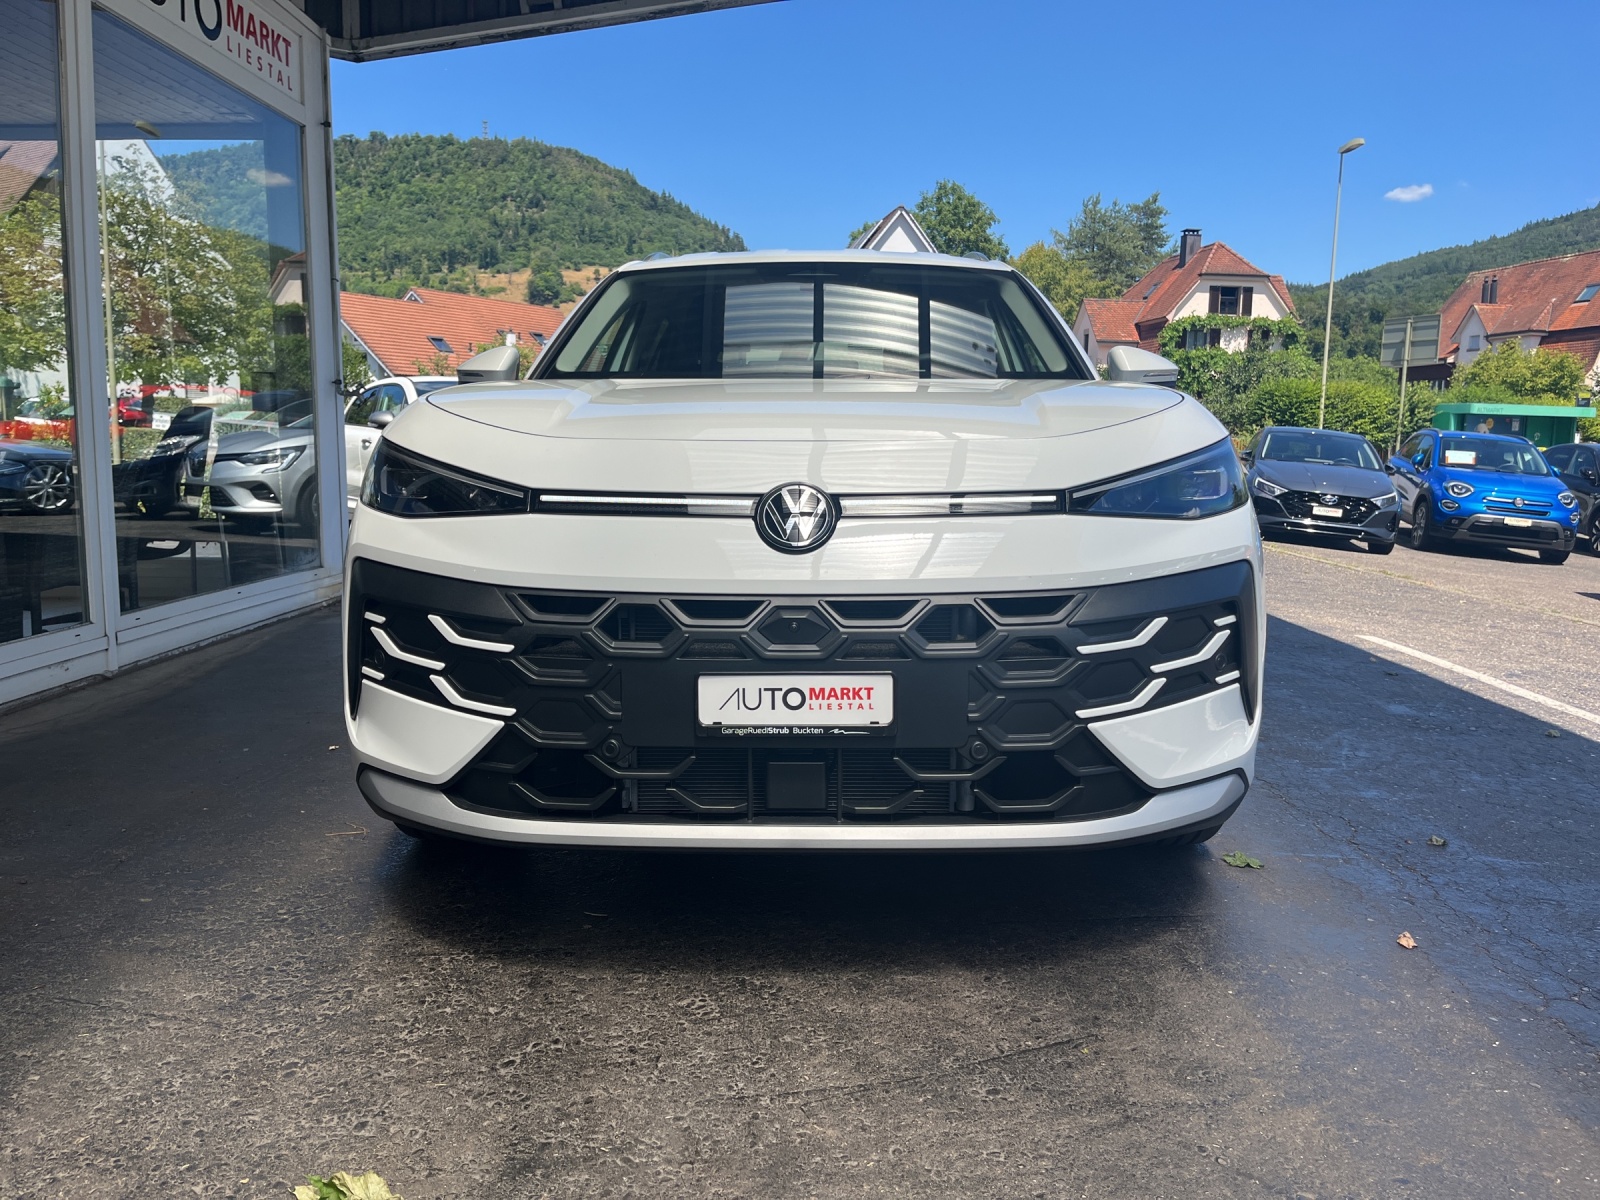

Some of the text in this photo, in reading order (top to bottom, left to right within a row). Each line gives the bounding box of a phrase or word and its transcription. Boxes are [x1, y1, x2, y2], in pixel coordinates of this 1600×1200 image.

[226, 0, 292, 67] MARKT
[227, 36, 293, 91] LIESTAL
[719, 687, 875, 711] AUTO MARKT
[808, 702, 875, 711] LIESTAL
[792, 726, 824, 735] Buckten
